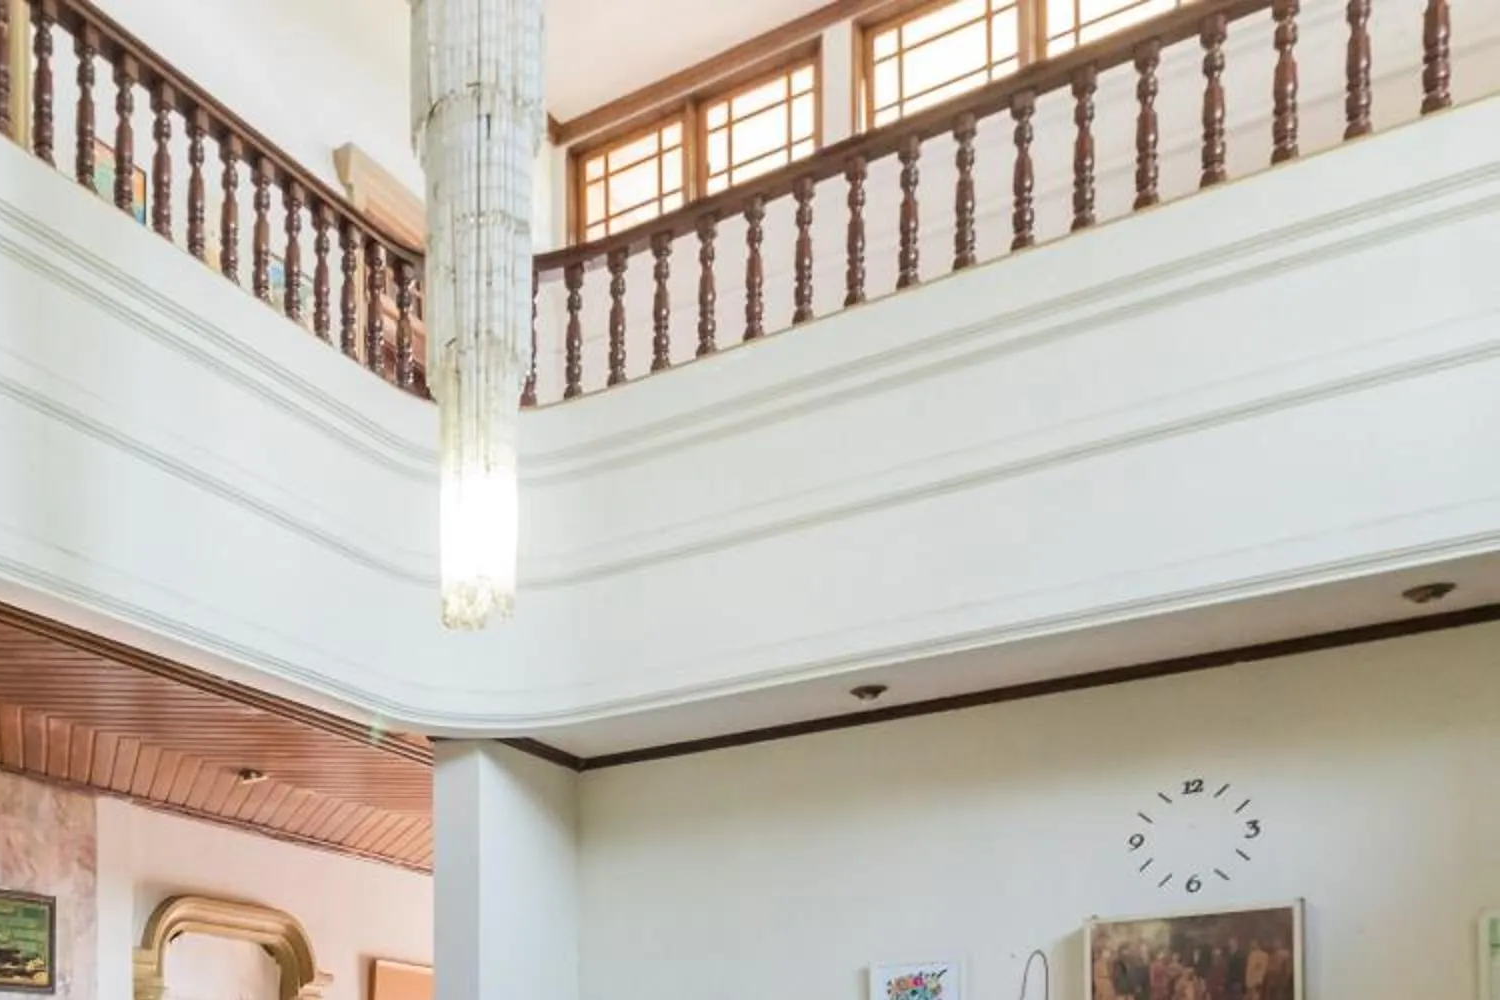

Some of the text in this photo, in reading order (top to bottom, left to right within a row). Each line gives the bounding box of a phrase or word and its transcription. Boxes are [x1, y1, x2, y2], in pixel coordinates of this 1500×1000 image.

[1181, 779, 1204, 795] 12
[1244, 819, 1261, 839] 3
[1128, 833, 1145, 852] 9
[1185, 874, 1202, 894] 6
